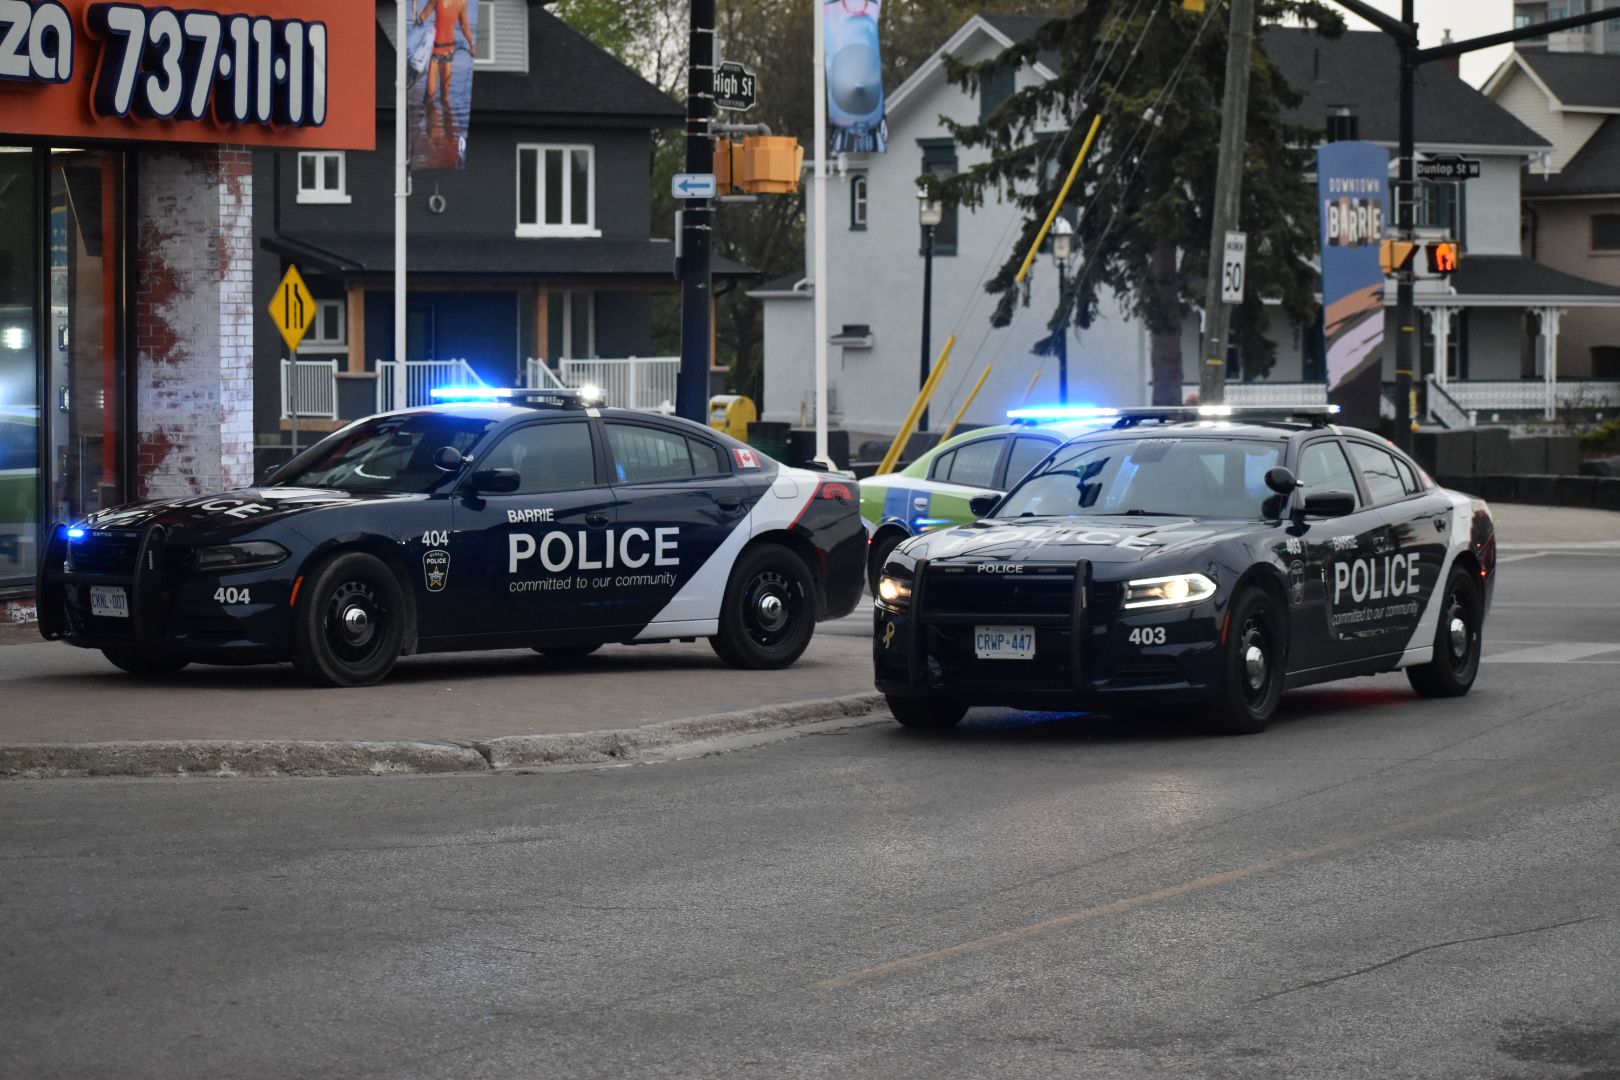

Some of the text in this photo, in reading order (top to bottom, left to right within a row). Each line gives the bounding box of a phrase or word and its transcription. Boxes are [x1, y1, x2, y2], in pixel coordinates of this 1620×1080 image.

[713, 73, 753, 99] High St
[1417, 163, 1479, 176] Dunlop St W
[1328, 177, 1380, 193] DOWNTOWN
[1328, 203, 1382, 243] BARRIE
[1225, 261, 1242, 293] 50
[507, 508, 555, 524] BARRIE
[421, 530, 449, 547] 404
[508, 526, 680, 574] POLICE
[426, 557, 447, 565] POLICE
[977, 564, 1024, 574] POLICE
[509, 571, 678, 593] committed to our community
[1333, 552, 1421, 606] POLICE
[213, 587, 251, 605] 404
[1332, 601, 1419, 627] committed to our community
[1128, 626, 1167, 645] 403
